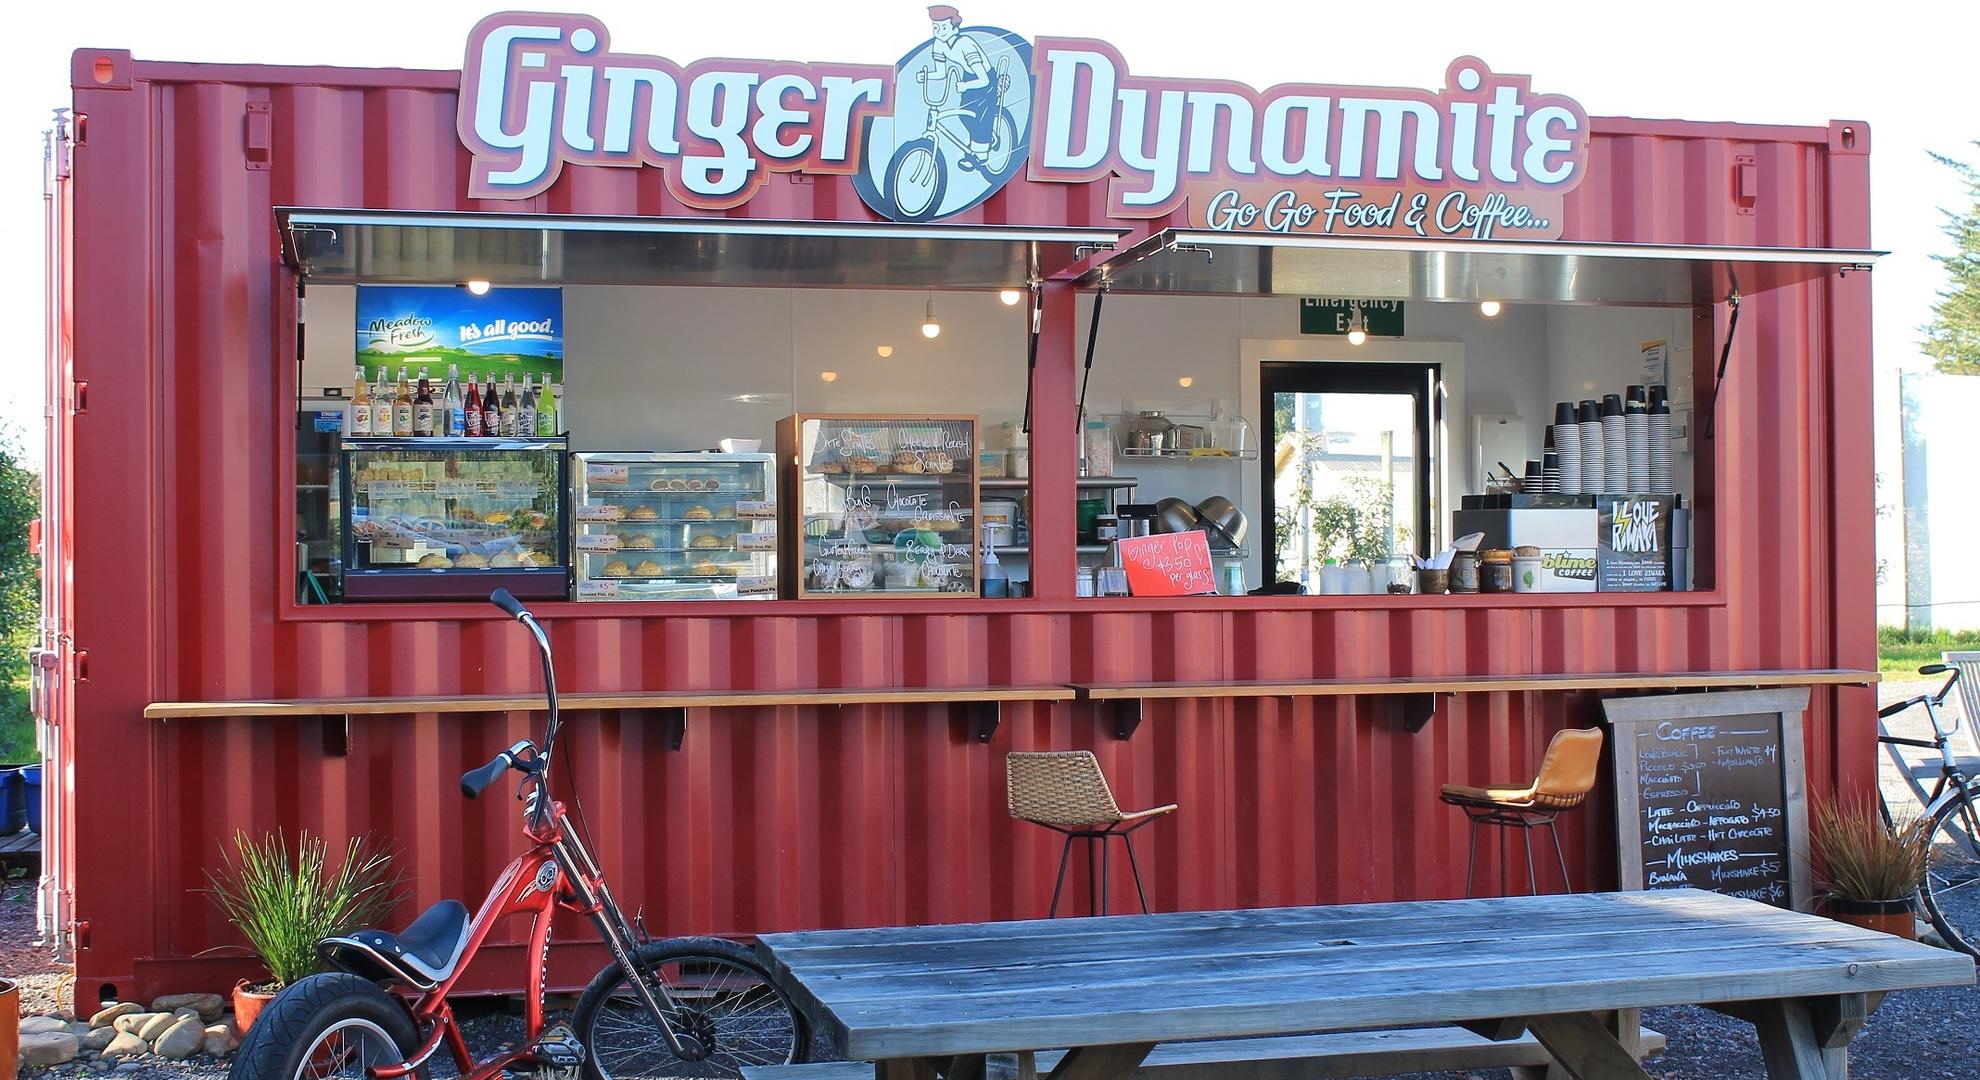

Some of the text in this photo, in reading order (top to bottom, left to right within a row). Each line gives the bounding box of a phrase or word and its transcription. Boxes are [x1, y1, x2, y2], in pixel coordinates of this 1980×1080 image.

[474, 24, 883, 195] Ginger
[1043, 49, 1577, 206] Dynamite
[1206, 189, 1261, 231] Go
[1263, 189, 1317, 233] Go
[1323, 187, 1402, 233] Food
[1403, 193, 1427, 236] &
[368, 313, 432, 338] Meadow
[460, 318, 554, 342] It's all good.
[1336, 313, 1369, 332] Ext
[390, 326, 426, 345] Fresh
